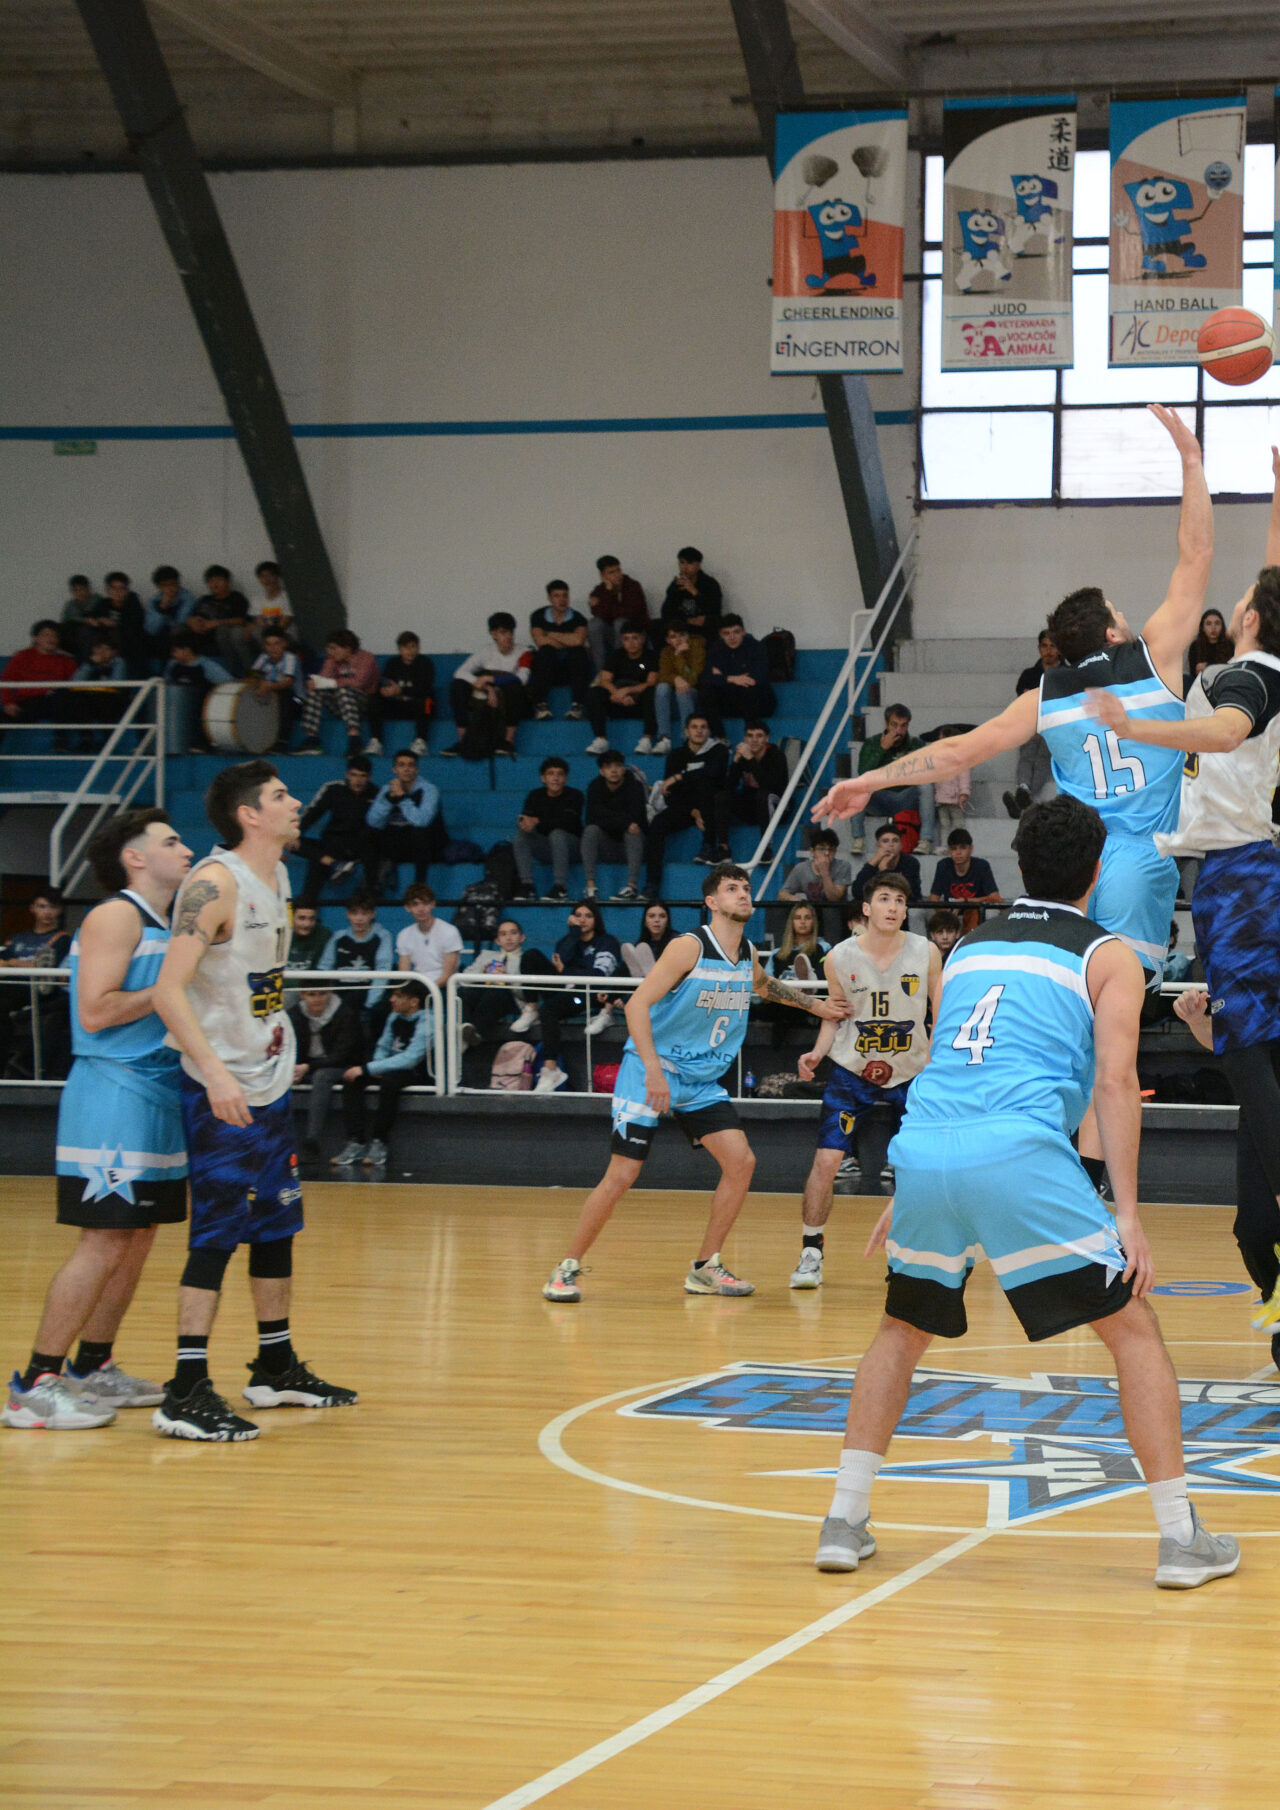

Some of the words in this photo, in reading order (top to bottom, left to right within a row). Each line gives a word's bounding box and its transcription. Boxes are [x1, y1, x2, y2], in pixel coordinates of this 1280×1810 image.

[989, 303, 1027, 315] JUDO
[1134, 299, 1176, 312] HAND
[1180, 297, 1219, 310] BALL
[782, 305, 895, 320] CHEERLENDING
[1008, 343, 1056, 356] ANIMAL
[1082, 729, 1147, 800] 15
[870, 991, 890, 1018] 15
[708, 1015, 730, 1048] 6
[951, 983, 1006, 1066] 4
[107, 1169, 120, 1183] E
